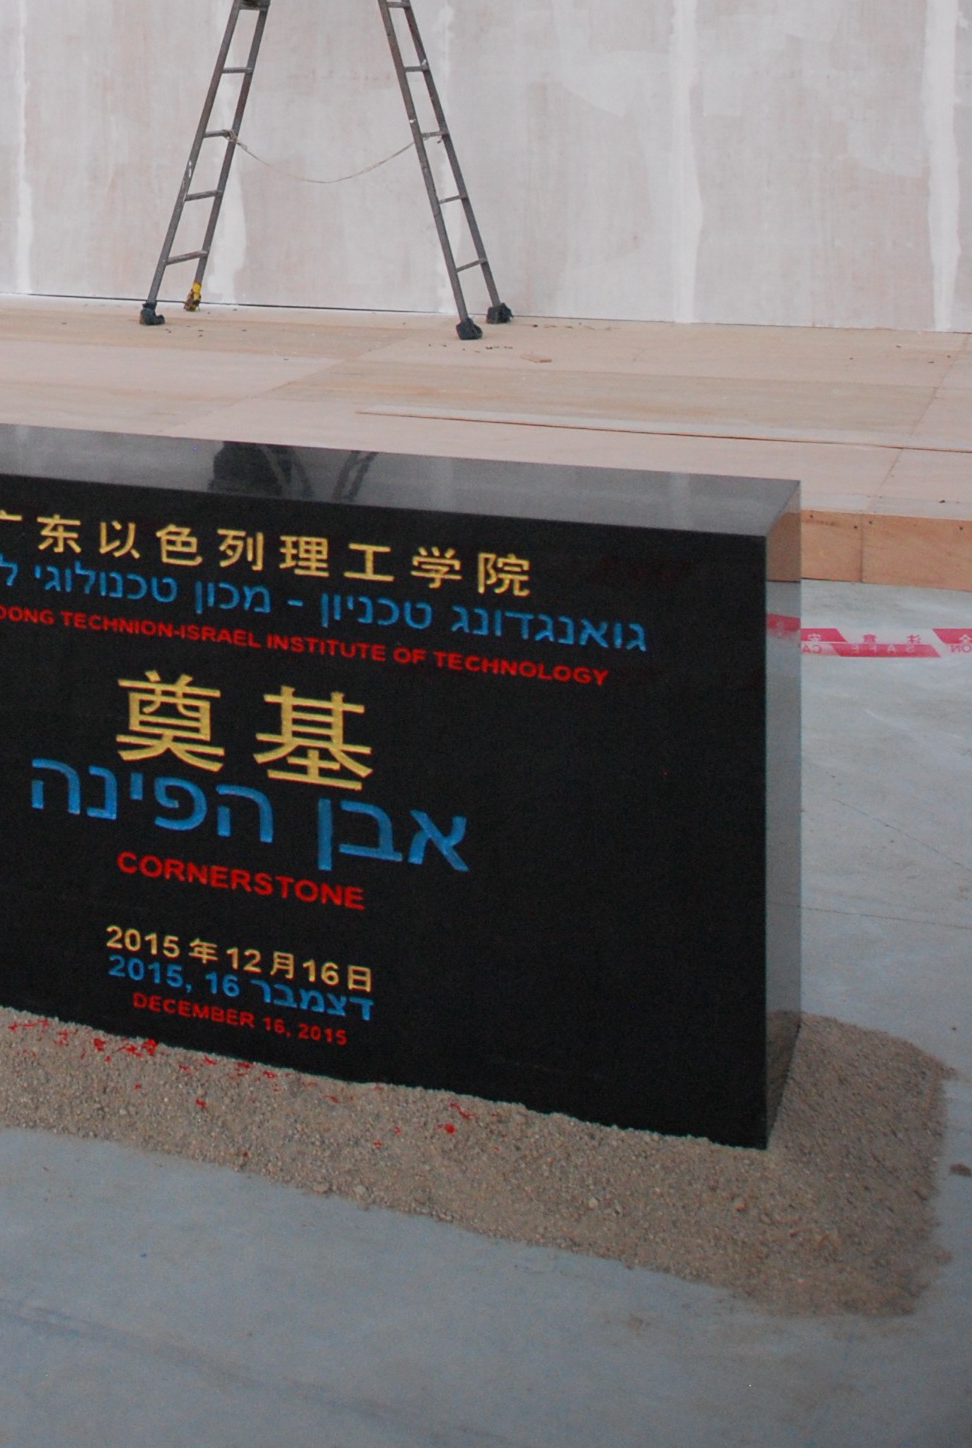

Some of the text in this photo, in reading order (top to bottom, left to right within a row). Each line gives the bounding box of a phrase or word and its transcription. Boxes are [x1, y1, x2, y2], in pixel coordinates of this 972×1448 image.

[33, 561, 178, 603] טכנולוגי
[195, 580, 271, 613] מכון
[320, 592, 433, 629] טכניון
[452, 604, 647, 651] גואנגדונג
[60, 609, 262, 649] TECHNION-ISRAEL
[266, 633, 386, 662] INSTITUTE
[392, 646, 427, 665] OF
[432, 651, 609, 686] TECHNOLOGY
[115, 670, 373, 790] 奠基
[30, 757, 469, 872] אבן הפינה
[116, 850, 366, 911] CORNERSTONE
[205, 971, 241, 998] 16
[250, 978, 374, 1021] דצמבר
[132, 991, 347, 1046] DECEMBER 16, 2015
